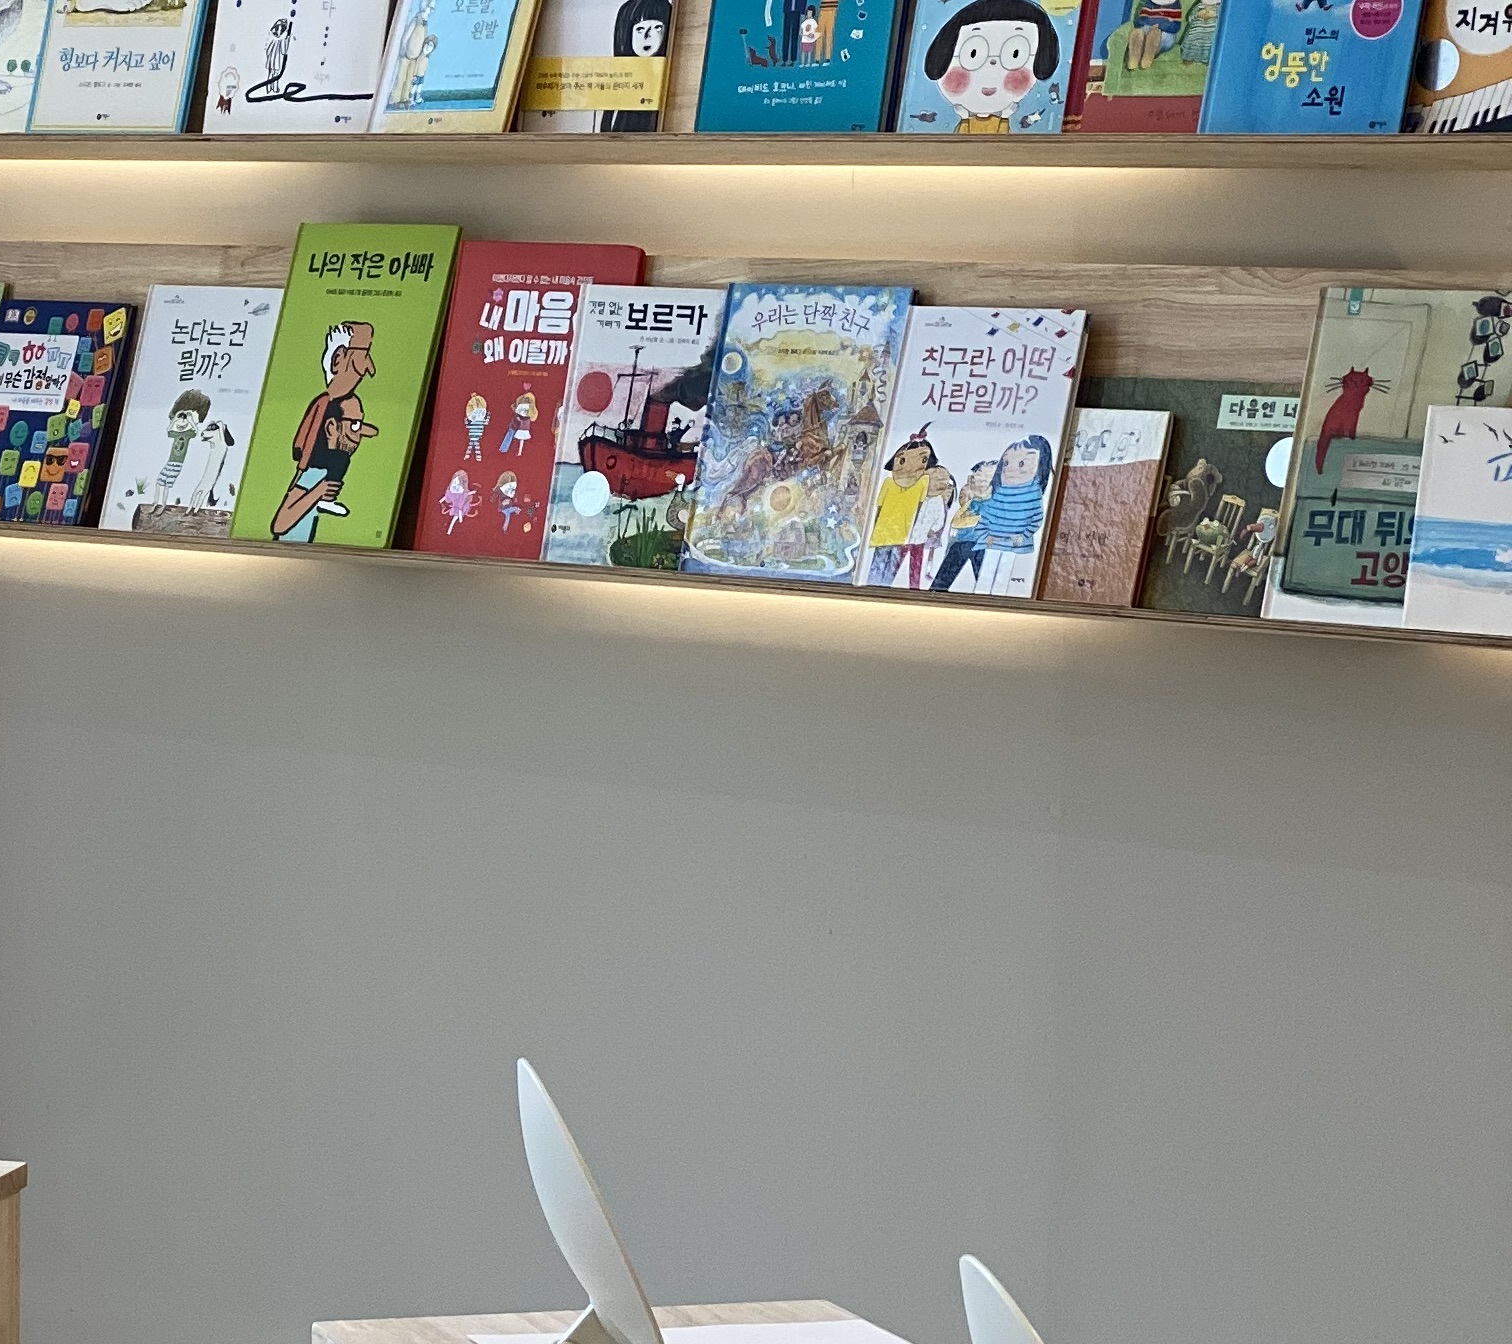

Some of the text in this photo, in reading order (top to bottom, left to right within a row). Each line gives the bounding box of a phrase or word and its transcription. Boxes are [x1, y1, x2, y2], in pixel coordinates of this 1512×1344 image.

[471, 19, 500, 40] 왼발
[59, 46, 176, 72] 형보다 커지고 싶어
[1261, 42, 1329, 87] 엉뚱한
[1301, 85, 1345, 116] 소원
[308, 251, 434, 282] 나의 작은 아빠
[479, 289, 578, 334] 내 마음
[624, 302, 708, 335] 보르카
[751, 301, 871, 337] 우리는 단짝 친구
[171, 319, 248, 346] 논다는 건
[177, 348, 231, 381] 뭘까?
[483, 336, 573, 365] 왜 이럴까
[922, 344, 1057, 381] 친구란 어떤
[4, 370, 22, 388] 무슨
[922, 380, 1039, 415] 사람일까?
[1229, 398, 1276, 419] 다음엔
[1303, 509, 1367, 547] 무대
